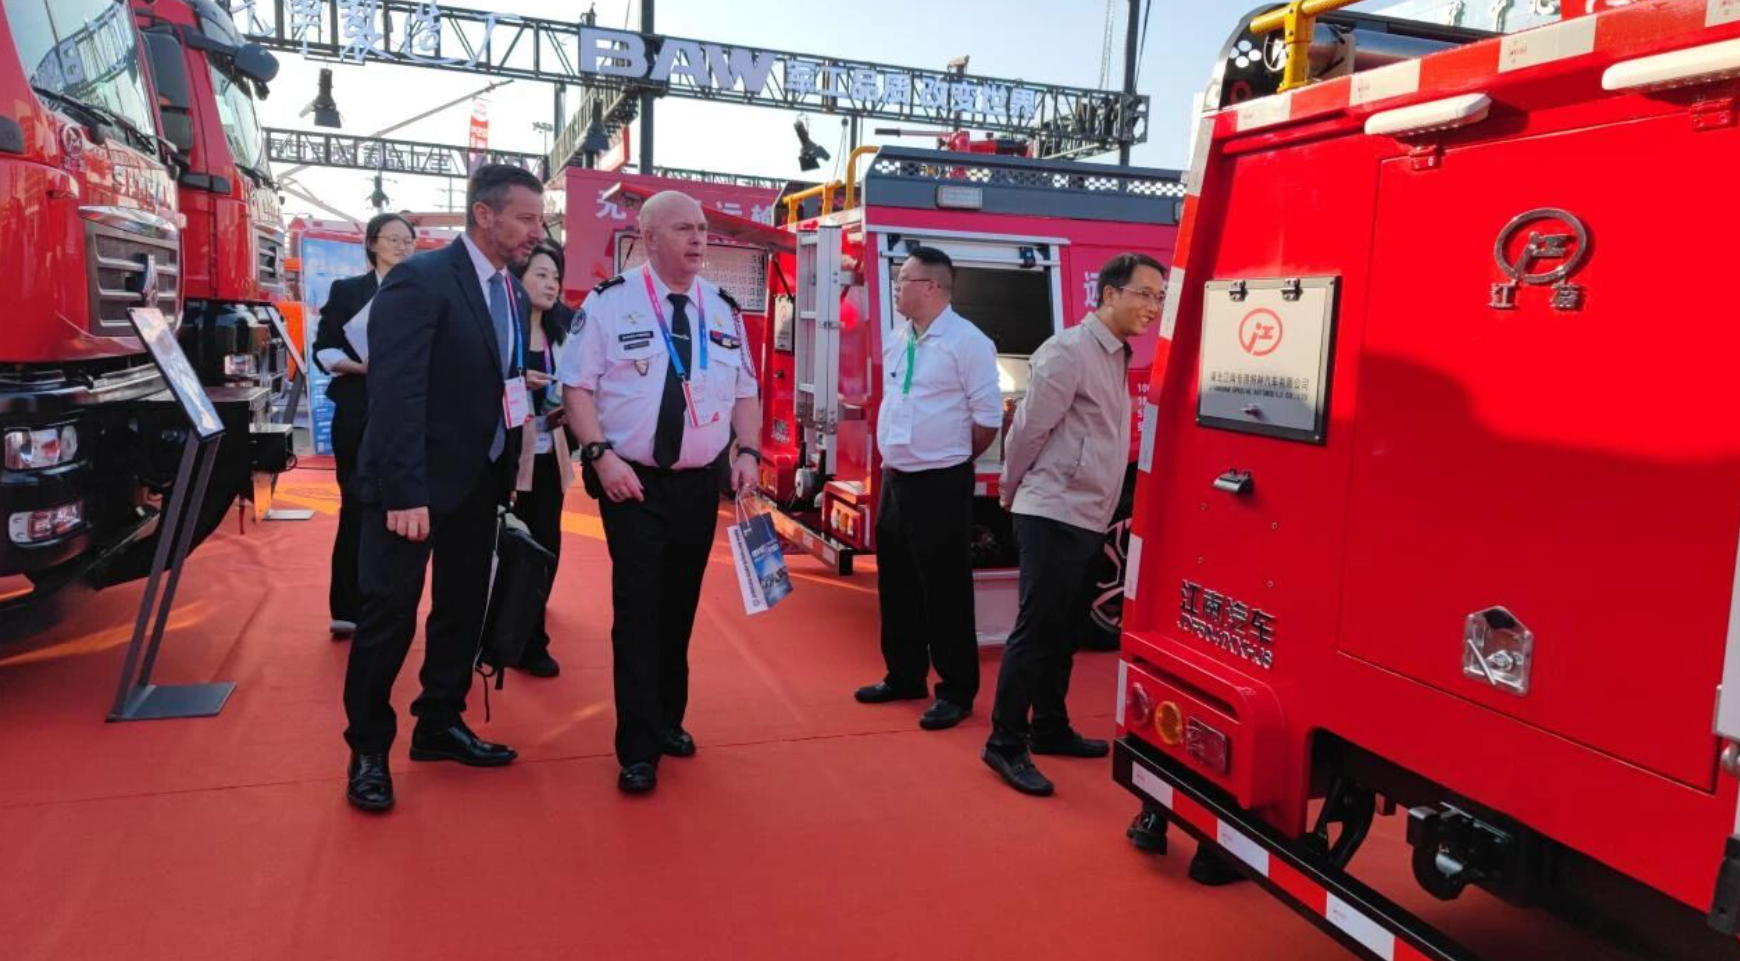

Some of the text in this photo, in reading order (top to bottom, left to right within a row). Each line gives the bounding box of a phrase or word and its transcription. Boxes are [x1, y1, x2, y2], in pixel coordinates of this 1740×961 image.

[579, 27, 777, 94] BAW
[919, 76, 1036, 120] 改变世界
[1180, 578, 1276, 642] 江南汽车
